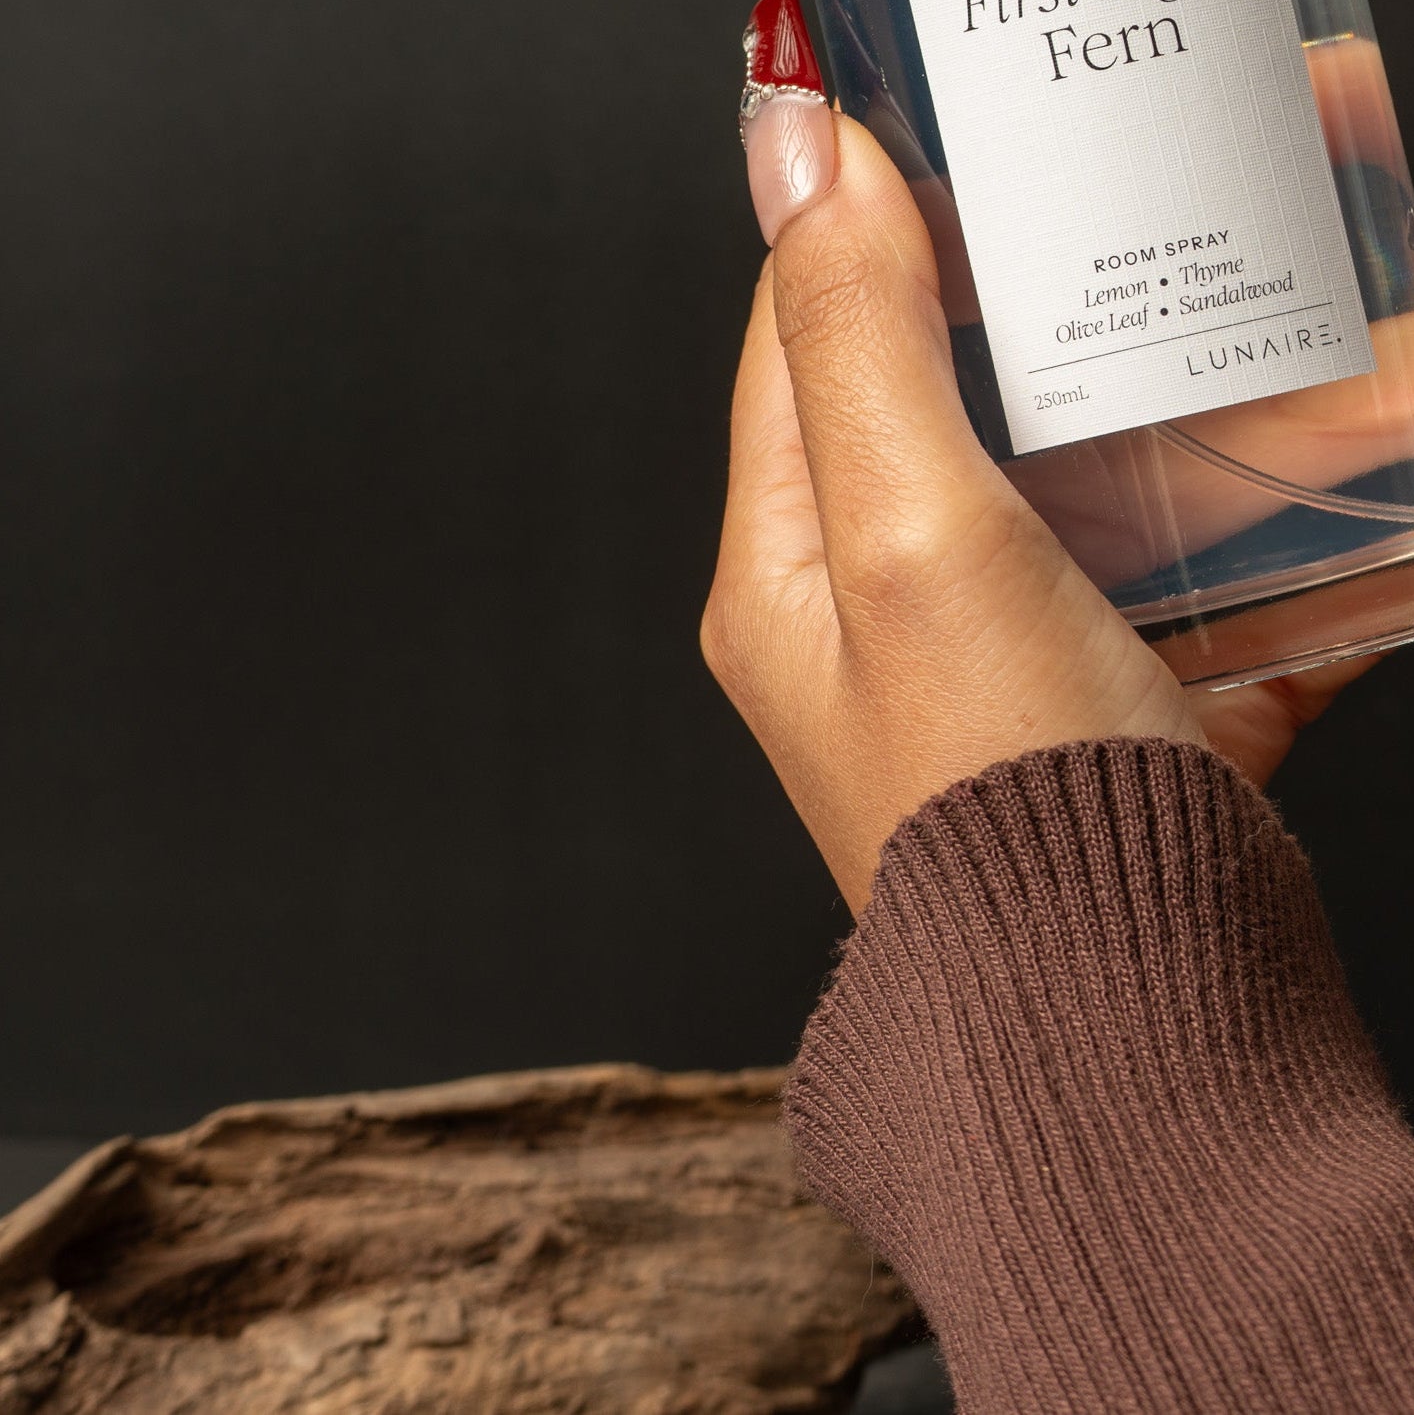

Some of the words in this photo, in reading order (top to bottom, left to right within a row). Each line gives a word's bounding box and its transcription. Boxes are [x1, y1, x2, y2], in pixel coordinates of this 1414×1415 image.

[1040, 16, 1189, 83] Fern
[1094, 246, 1157, 273] ROOM
[1165, 229, 1230, 257] SPRAY
[1055, 317, 1105, 344] Olive
[1109, 304, 1149, 332] Leaf
[1179, 271, 1294, 315] Sandalwood
[1085, 280, 1149, 308] Lemon
[1178, 257, 1245, 289] Thyme
[1034, 386, 1090, 410] 250mL
